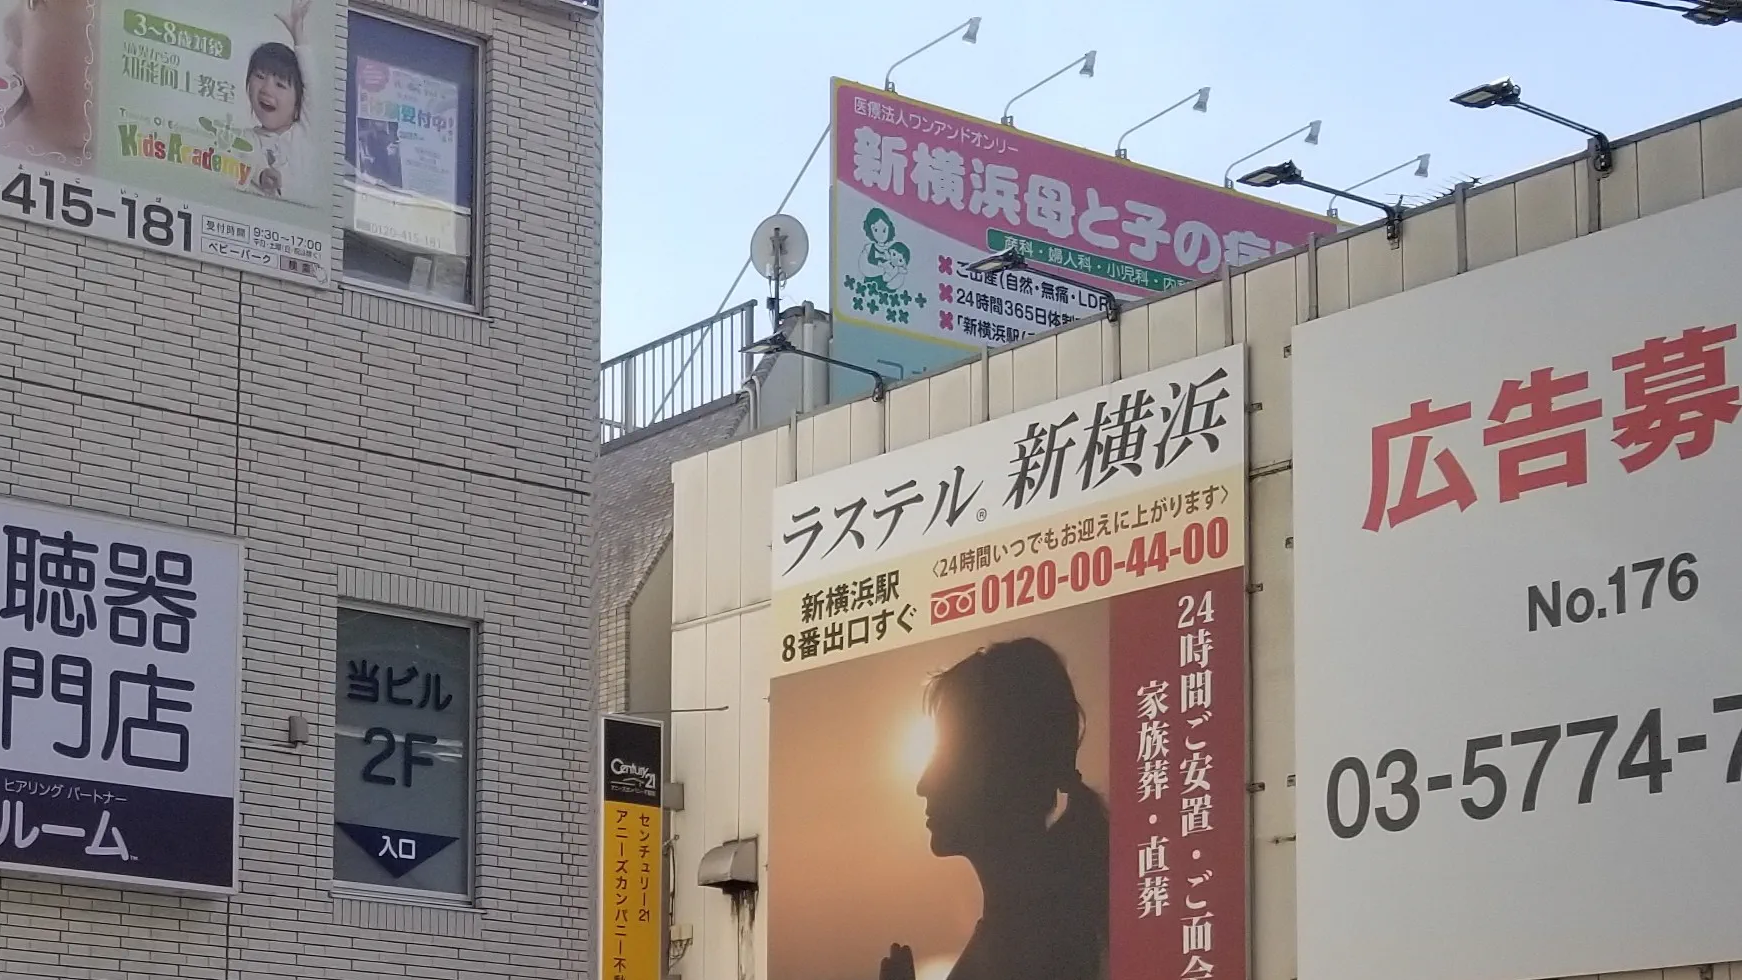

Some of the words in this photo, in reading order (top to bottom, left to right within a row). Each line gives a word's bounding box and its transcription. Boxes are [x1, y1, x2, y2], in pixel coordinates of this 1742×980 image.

[854, 96, 1019, 154] 医療法人ワンアンドオンリー
[206, 220, 246, 238] 受付時間
[208, 243, 271, 264] ベビーパーク
[1361, 323, 1742, 533] 広告募
[781, 465, 985, 578] ラステル
[1001, 367, 1232, 510] 新横浜
[981, 516, 1230, 615] 0120-00-44-00
[1527, 551, 1700, 632] No.176
[801, 570, 901, 625] 新横浜駅
[782, 603, 919, 664] 8番出口すぐ
[347, 659, 453, 711] 当ビル
[362, 726, 438, 788] 2F
[4, 777, 64, 799] ヒアリング
[67, 785, 128, 804] パートナー
[1136, 679, 1170, 920] 家族葬・直葬
[378, 835, 416, 860] 入口
[638, 812, 651, 923] センチュリー21
